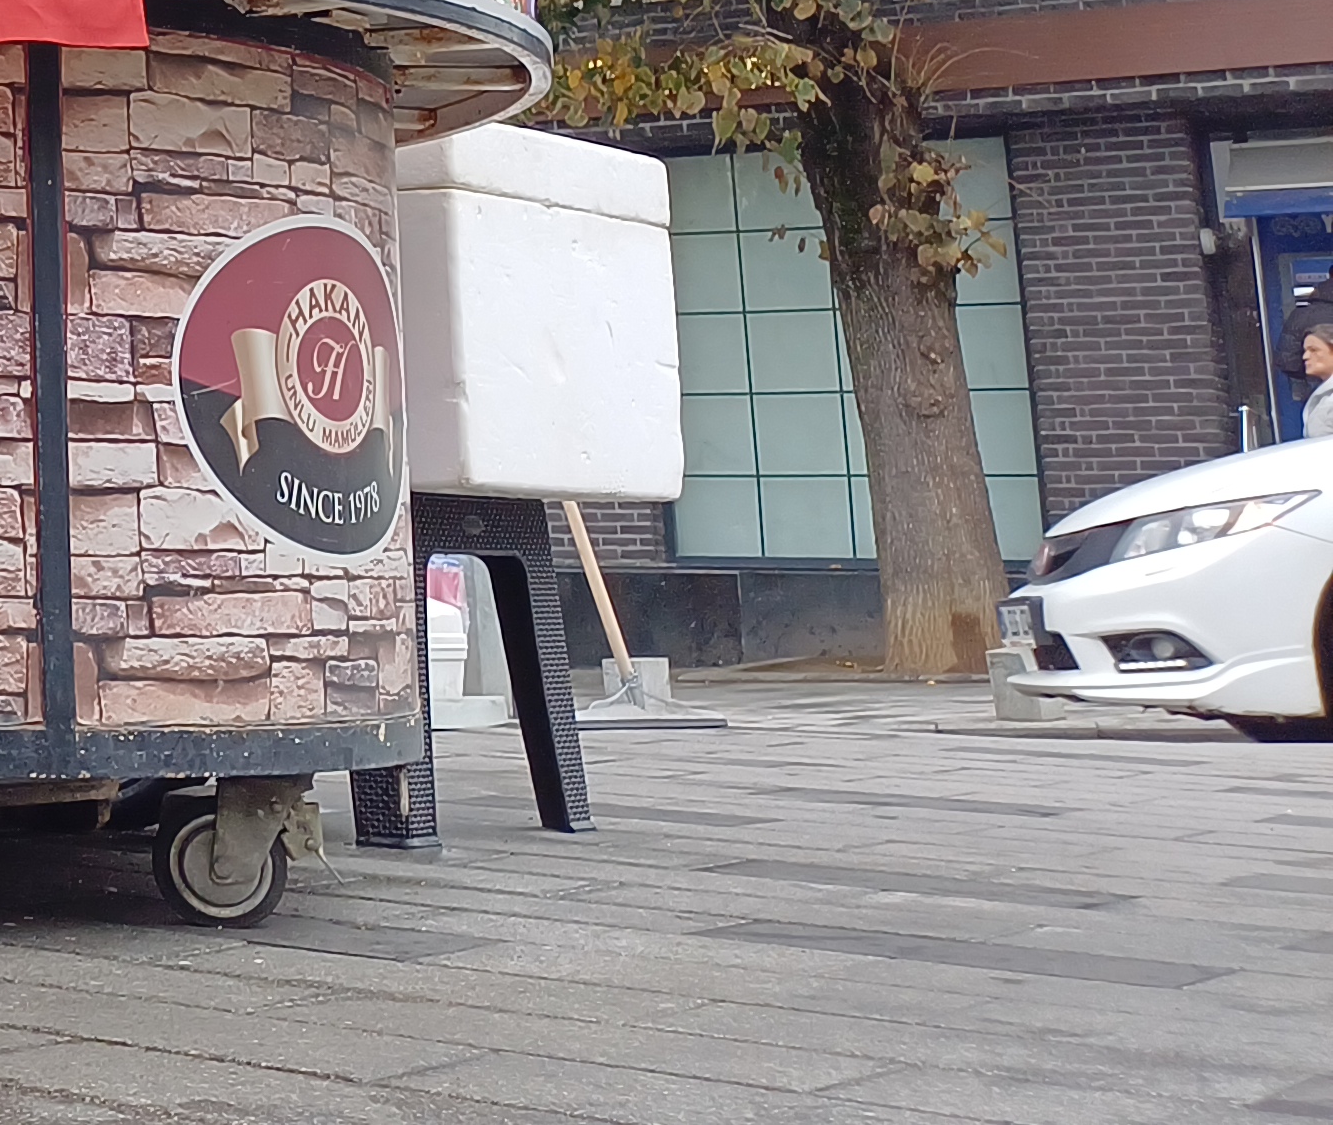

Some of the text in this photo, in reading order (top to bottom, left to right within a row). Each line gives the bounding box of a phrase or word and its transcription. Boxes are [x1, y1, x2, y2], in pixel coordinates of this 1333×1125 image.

[287, 282, 367, 343] HAKAN
[275, 471, 381, 525] SINCE 1978
